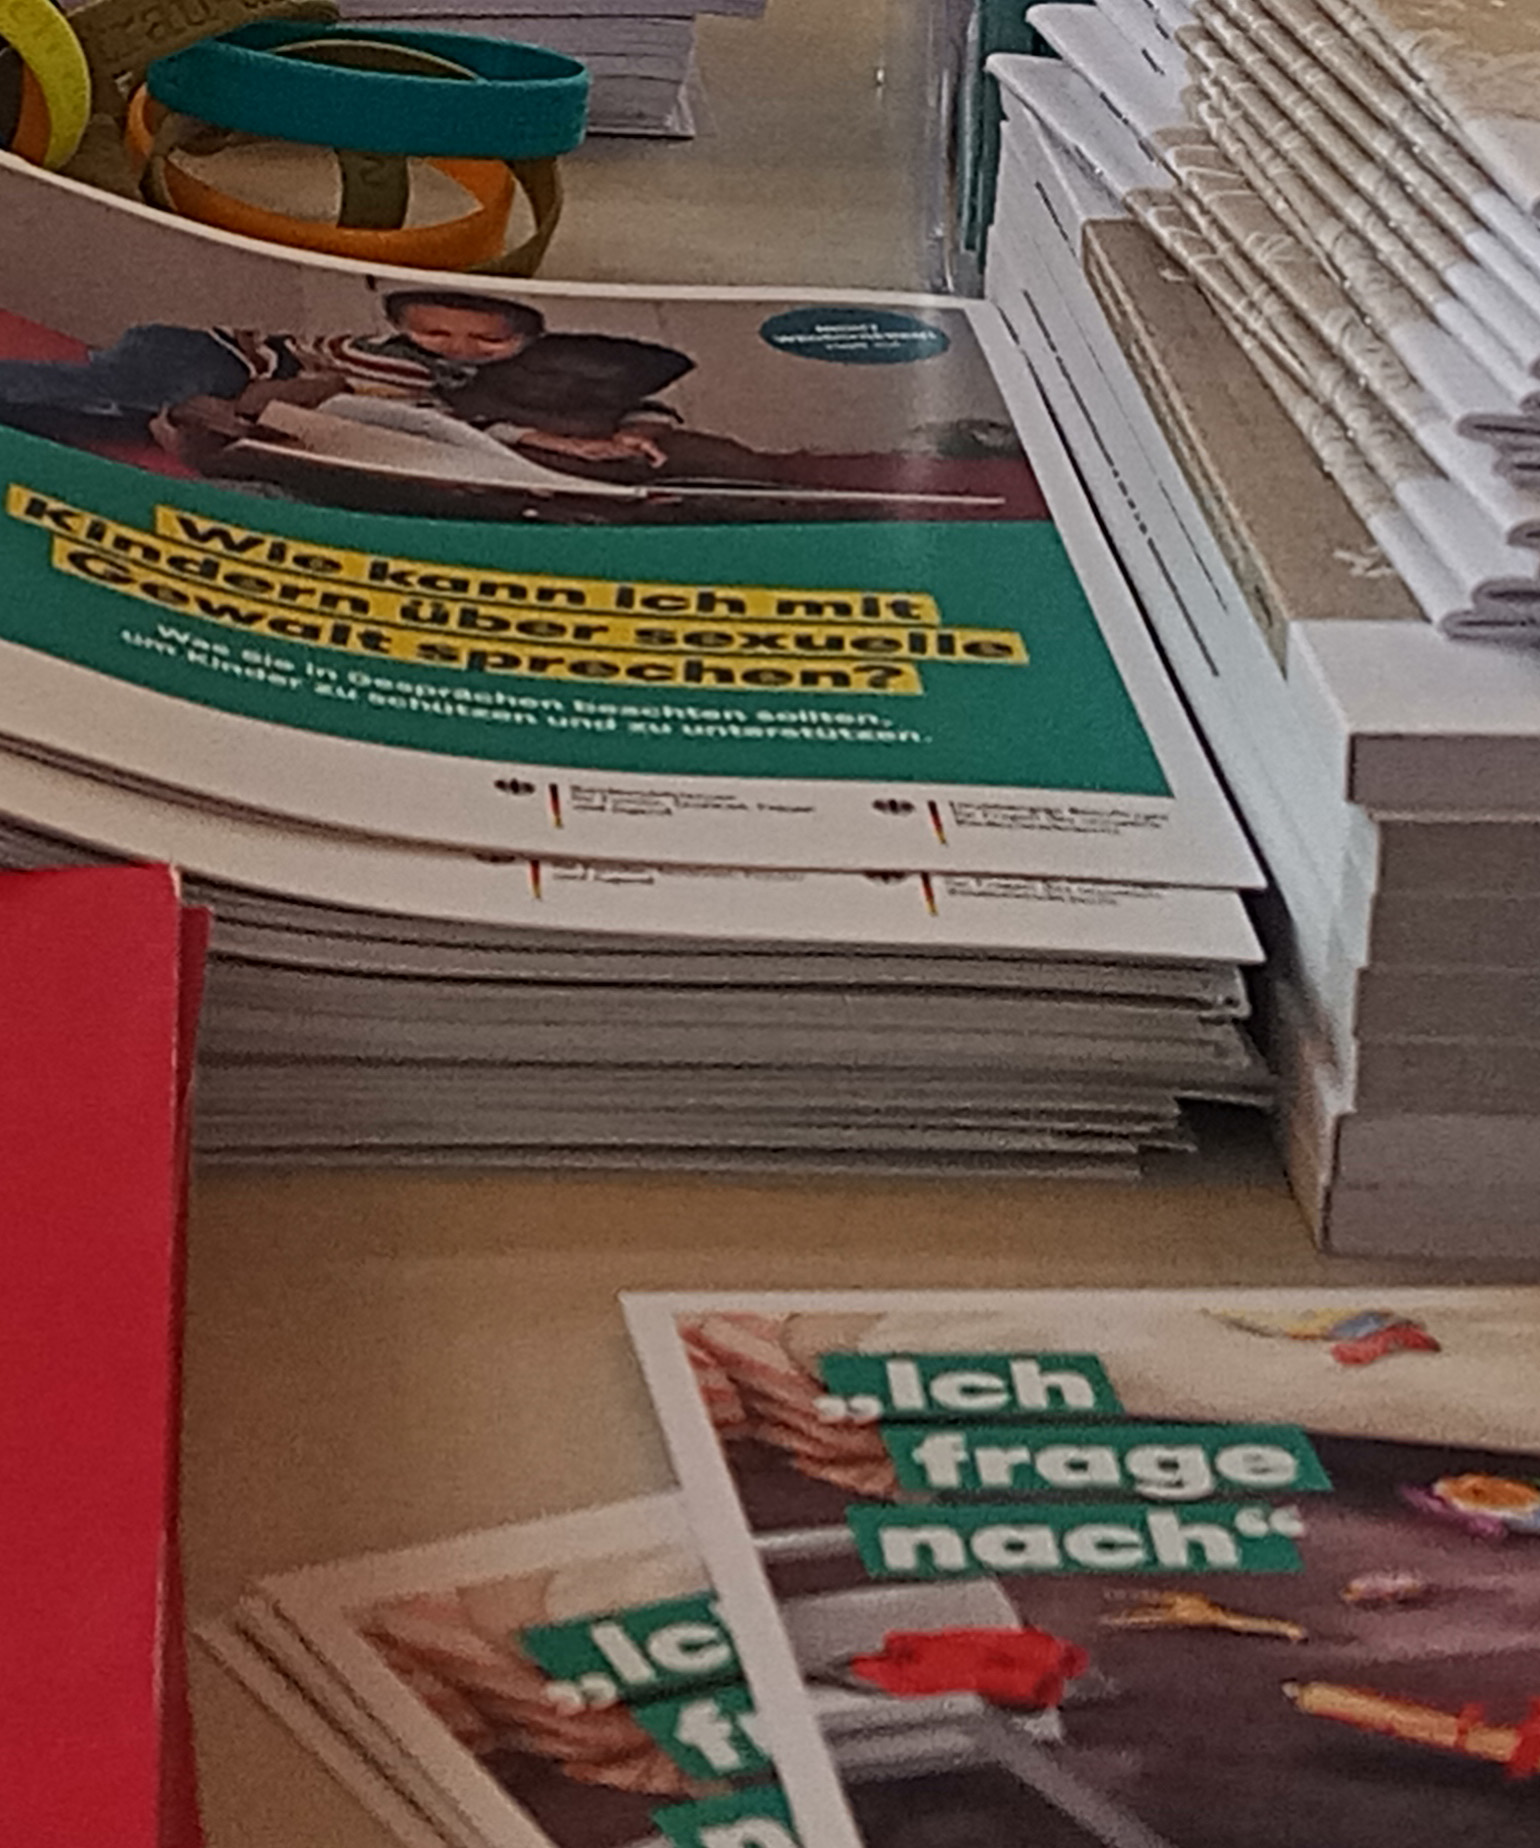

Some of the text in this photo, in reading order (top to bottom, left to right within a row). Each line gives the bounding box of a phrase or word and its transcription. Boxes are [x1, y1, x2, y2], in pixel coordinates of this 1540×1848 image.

[20, 494, 1015, 662] Kindern über sexuelle
[65, 549, 907, 693] Gewalt sprechen?
[173, 514, 924, 624] Wie kann ich mit
[157, 622, 232, 656] Was
[185, 648, 306, 692] Kinder
[545, 713, 617, 732] und
[912, 1431, 1300, 1500] frage
[546, 1597, 736, 1715] „Ic
